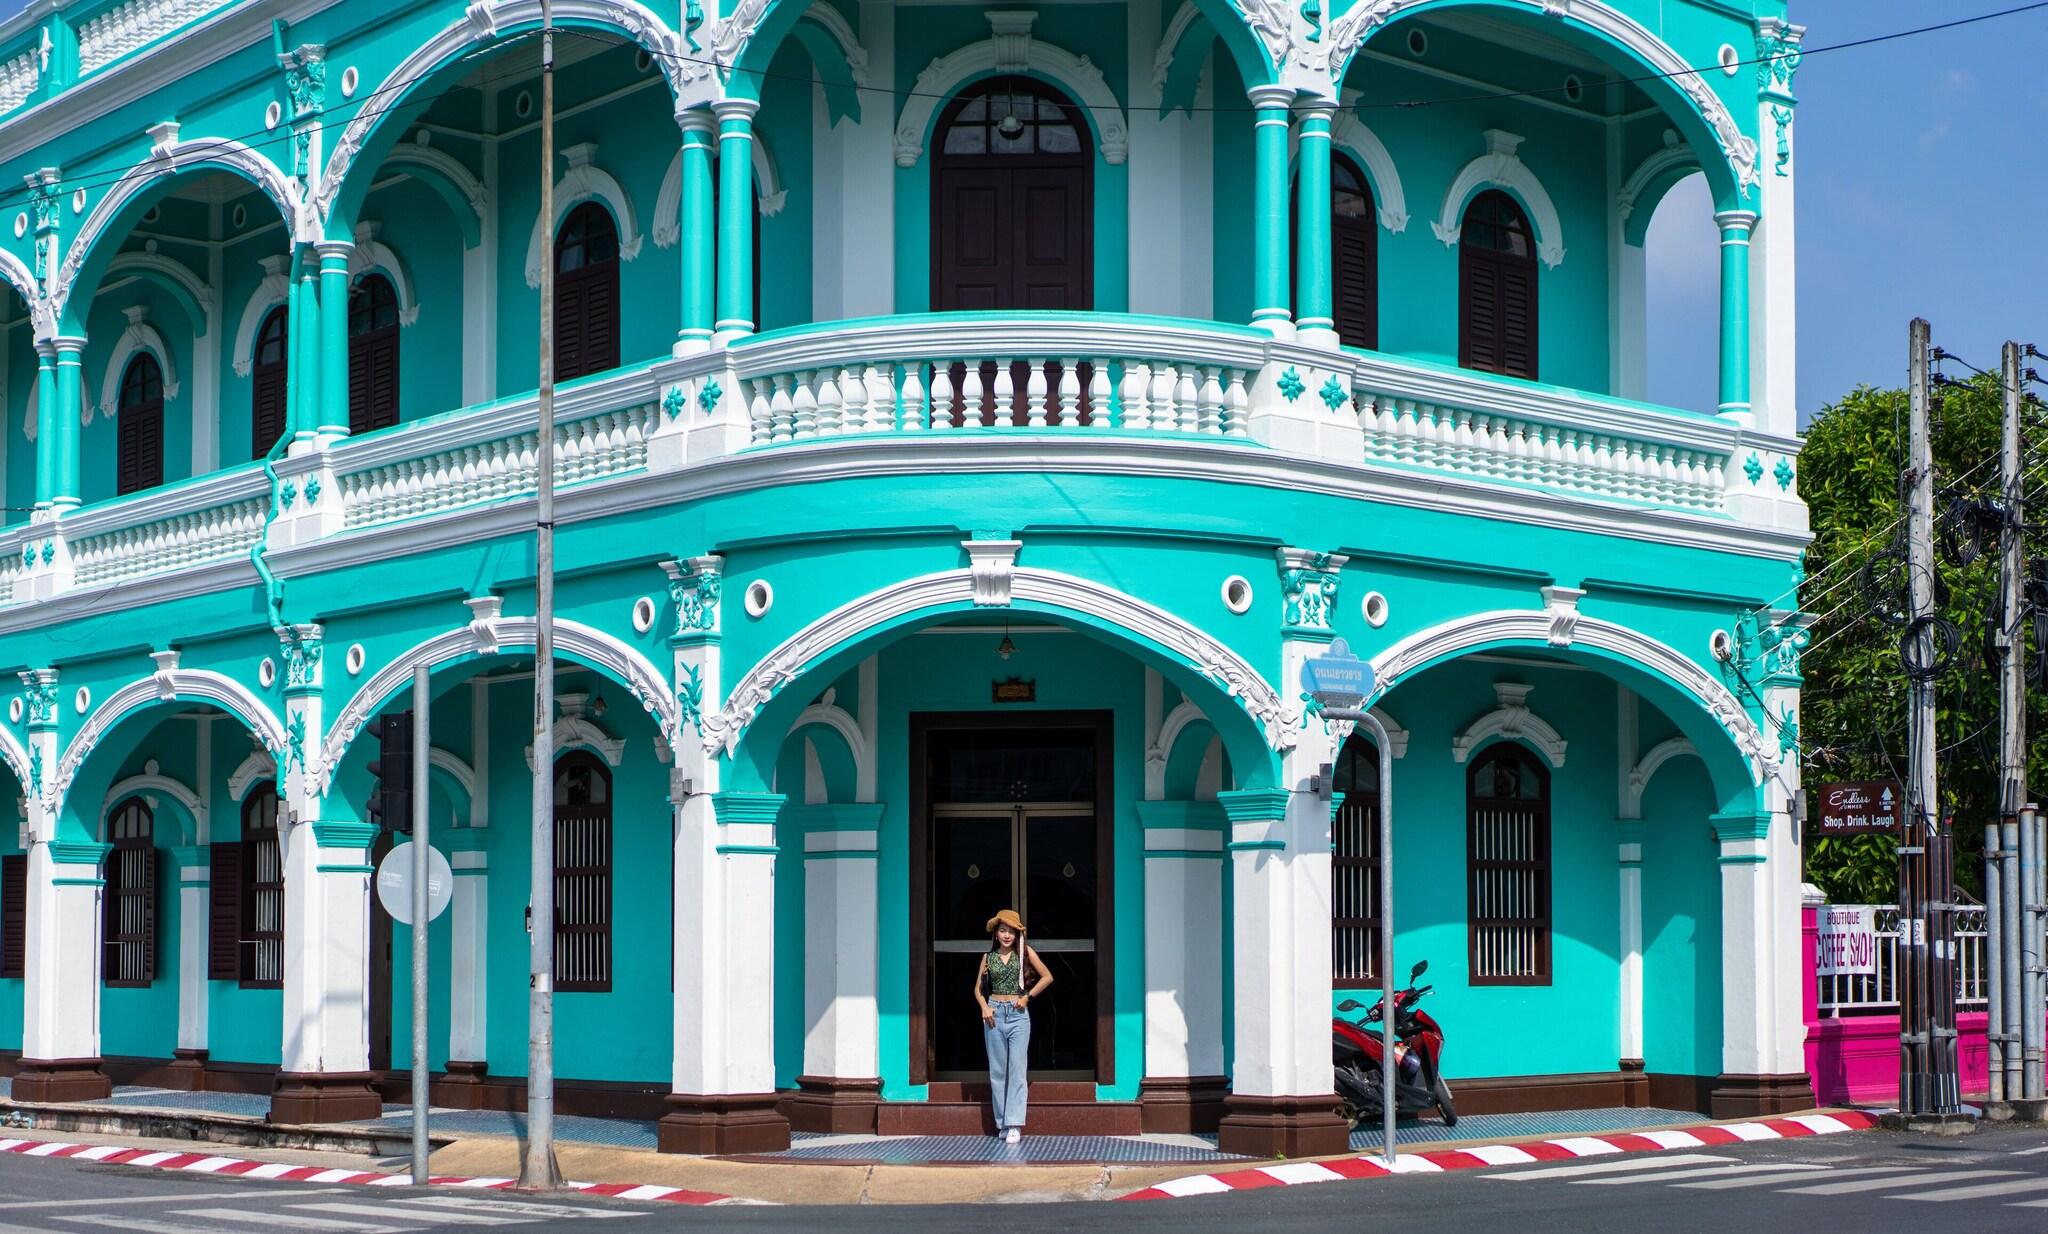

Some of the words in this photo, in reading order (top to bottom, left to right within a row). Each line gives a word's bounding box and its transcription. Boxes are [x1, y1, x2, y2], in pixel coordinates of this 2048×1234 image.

[1829, 791, 1871, 806] Endless
[1824, 815, 1845, 829] Shop.
[1847, 814, 1870, 826] Drink.
[1871, 813, 1895, 828] Laugh
[1827, 911, 1860, 926] BOUTIQUE
